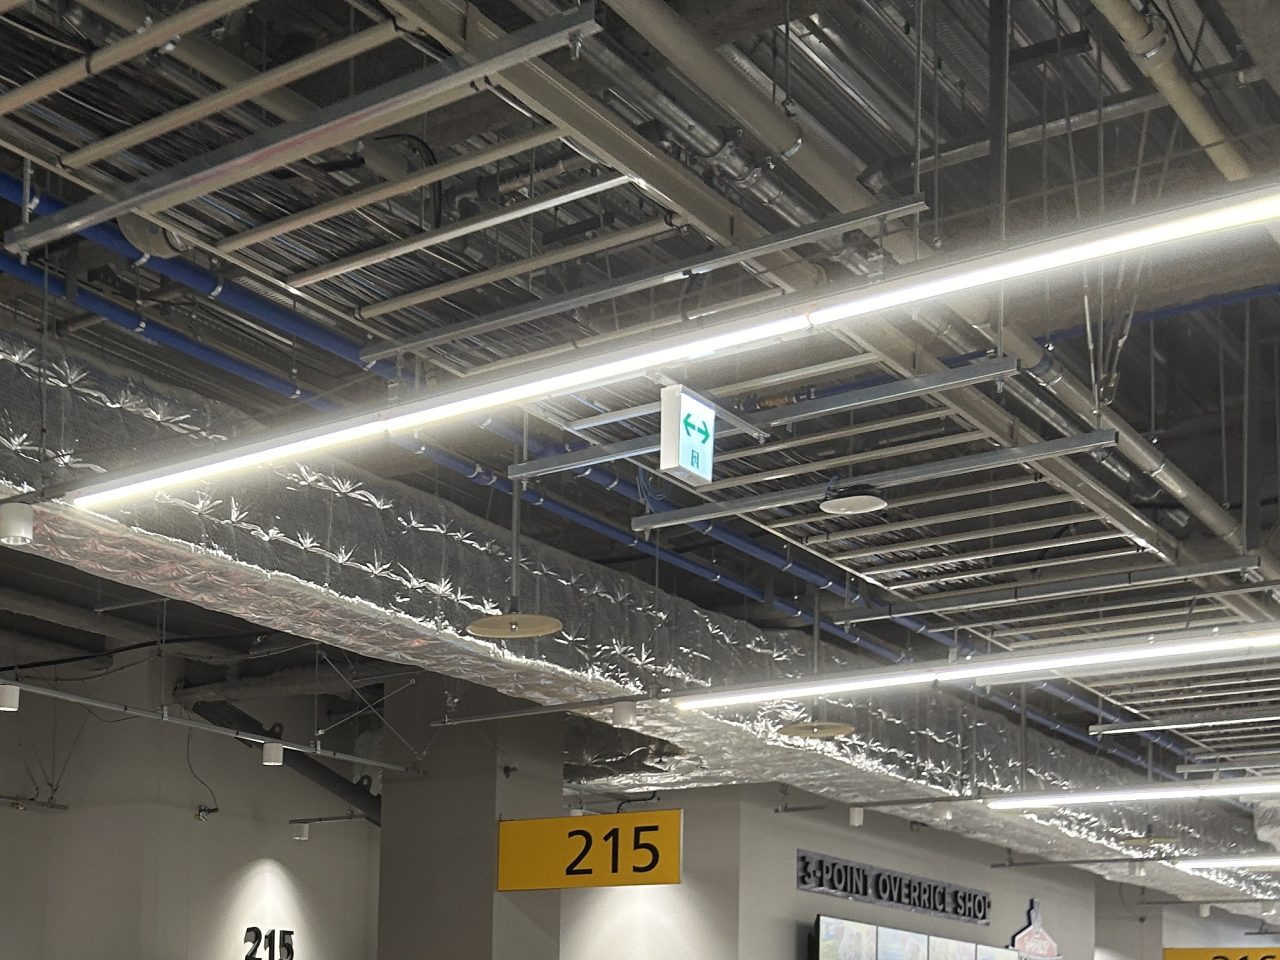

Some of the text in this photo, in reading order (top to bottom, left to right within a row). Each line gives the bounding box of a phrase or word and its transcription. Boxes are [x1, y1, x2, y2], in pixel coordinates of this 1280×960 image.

[566, 825, 660, 875] 215
[800, 857, 871, 896] 3-POINT
[877, 872, 953, 912] OVERRICE
